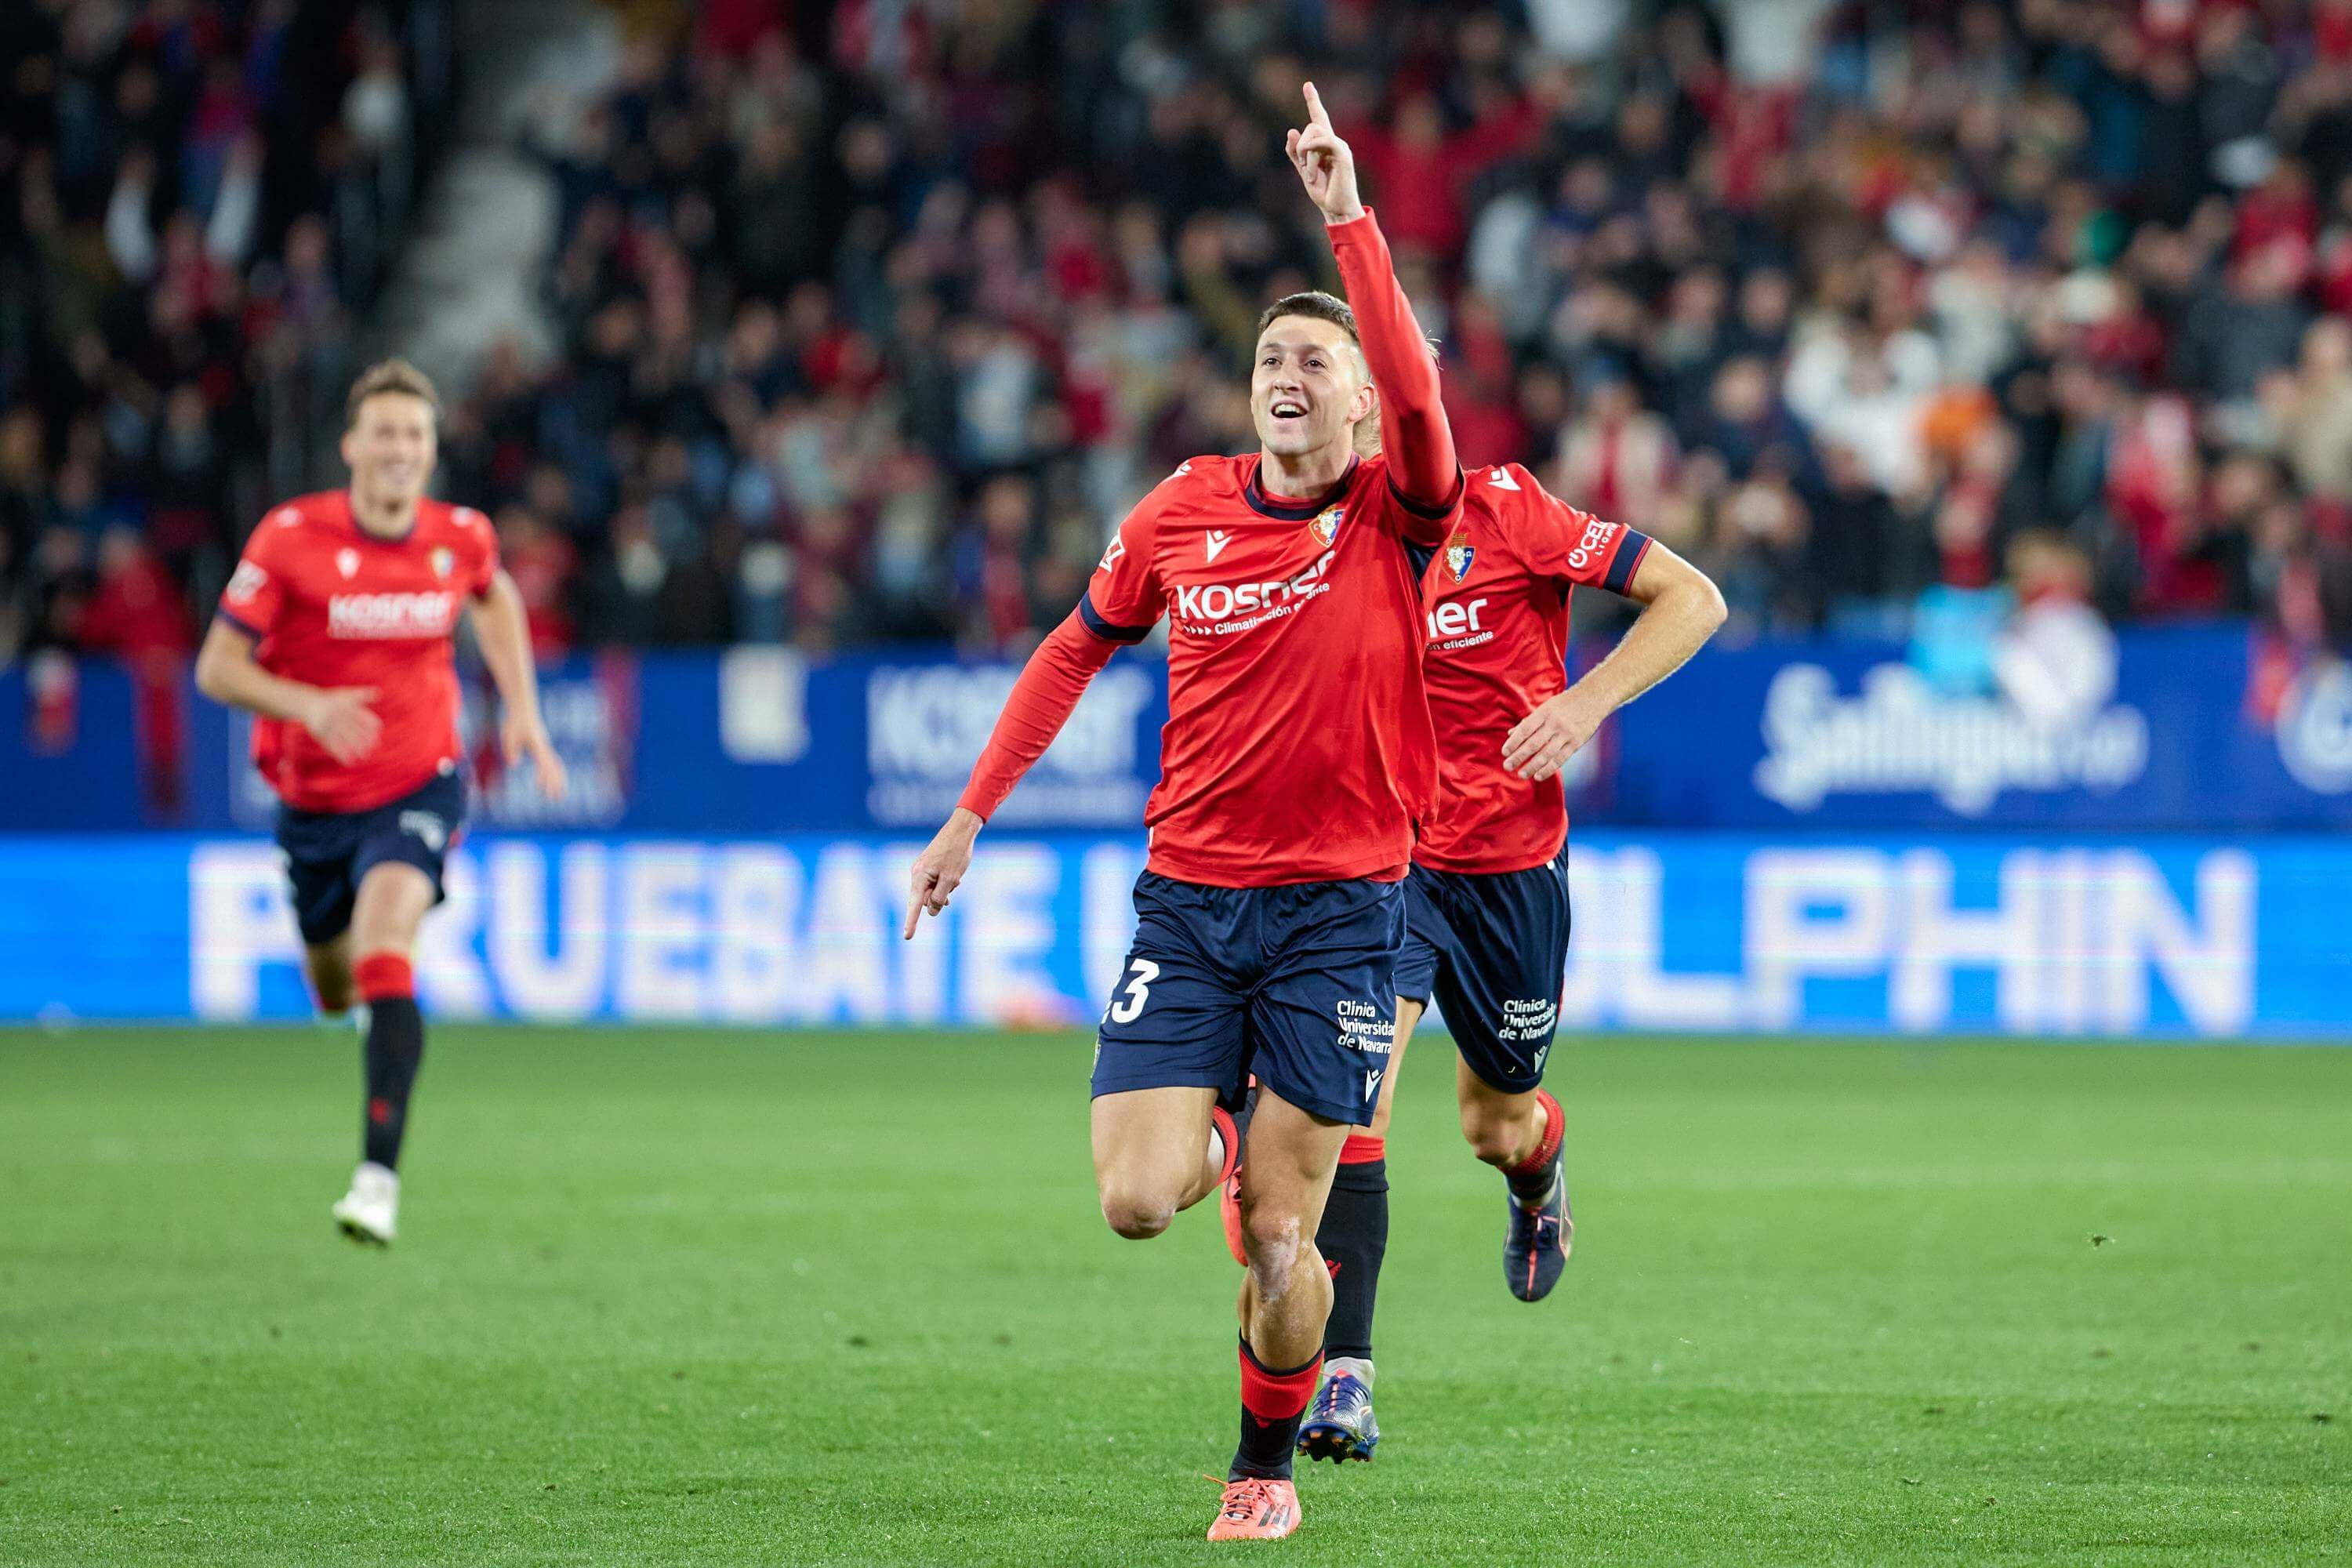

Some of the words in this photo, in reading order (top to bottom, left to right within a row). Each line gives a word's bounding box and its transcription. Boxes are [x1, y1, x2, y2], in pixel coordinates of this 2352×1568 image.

[1214, 605, 1291, 635] Climatición
[1443, 630, 1494, 650] eficiente
[1101, 958, 1160, 1024] 3
[1337, 1000, 1376, 1018] Clínica
[1503, 998, 1548, 1014] Clínica
[1503, 1003, 1557, 1028] Universid
[1498, 1026, 1517, 1040] de
[1337, 1033, 1356, 1048] de
[1357, 1035, 1392, 1054] Navarra
